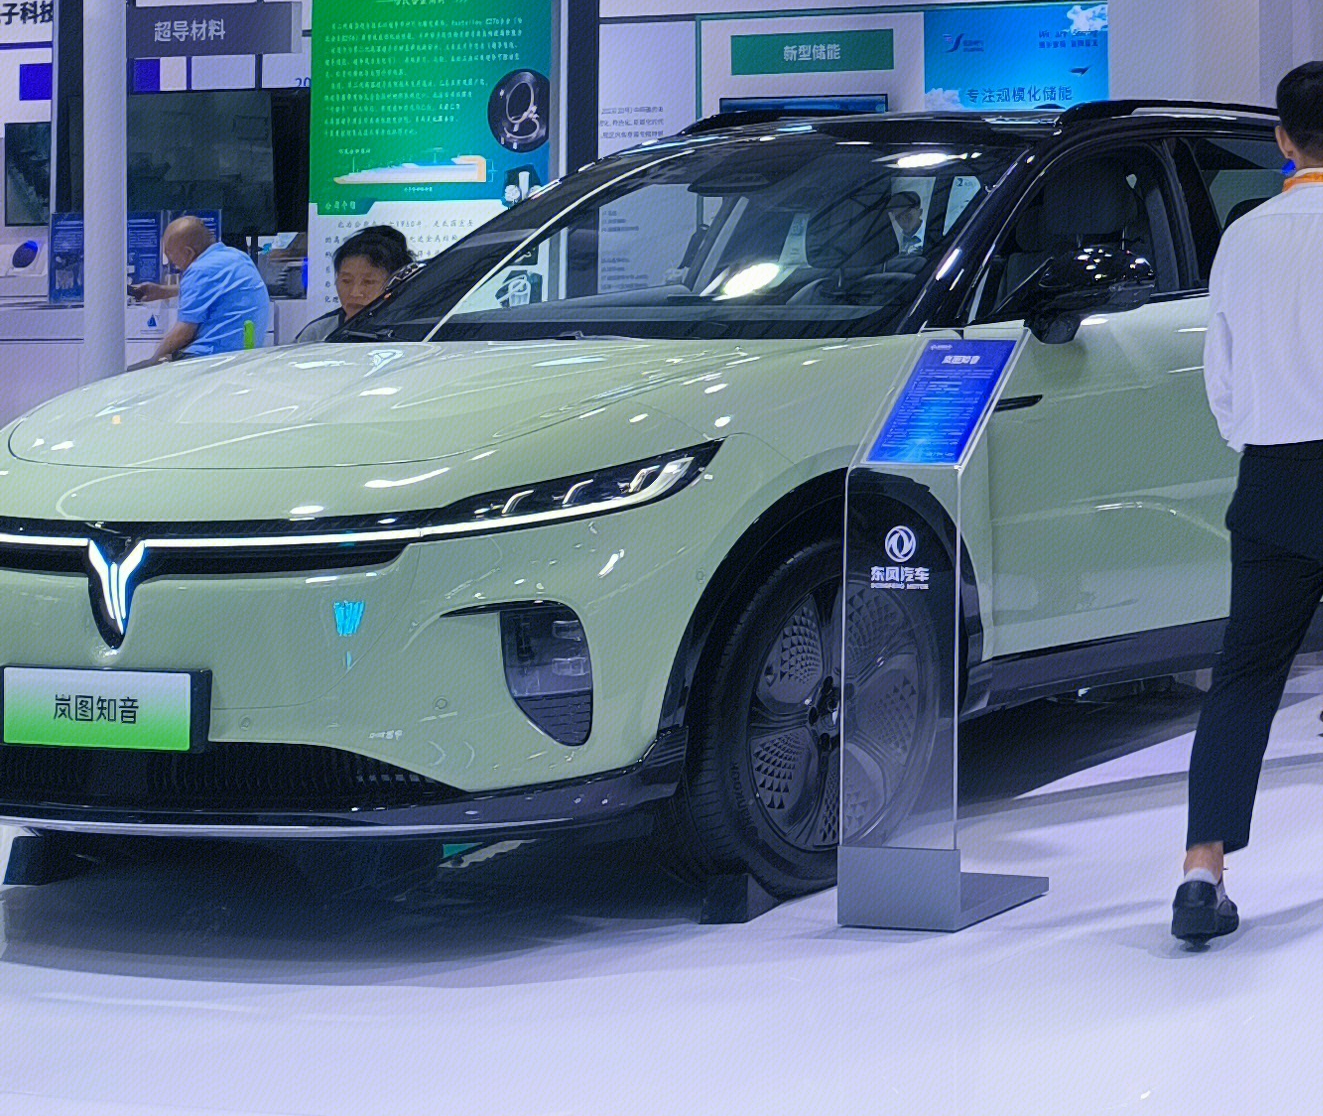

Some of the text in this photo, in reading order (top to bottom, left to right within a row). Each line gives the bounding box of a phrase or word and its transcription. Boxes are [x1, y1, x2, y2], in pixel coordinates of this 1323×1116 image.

[154, 18, 226, 42] 超导材料
[783, 44, 841, 62] 新型储能
[966, 86, 1073, 104] 专注规模化储能
[870, 566, 930, 582] 东风汽车
[54, 694, 139, 724] 岚图知音
